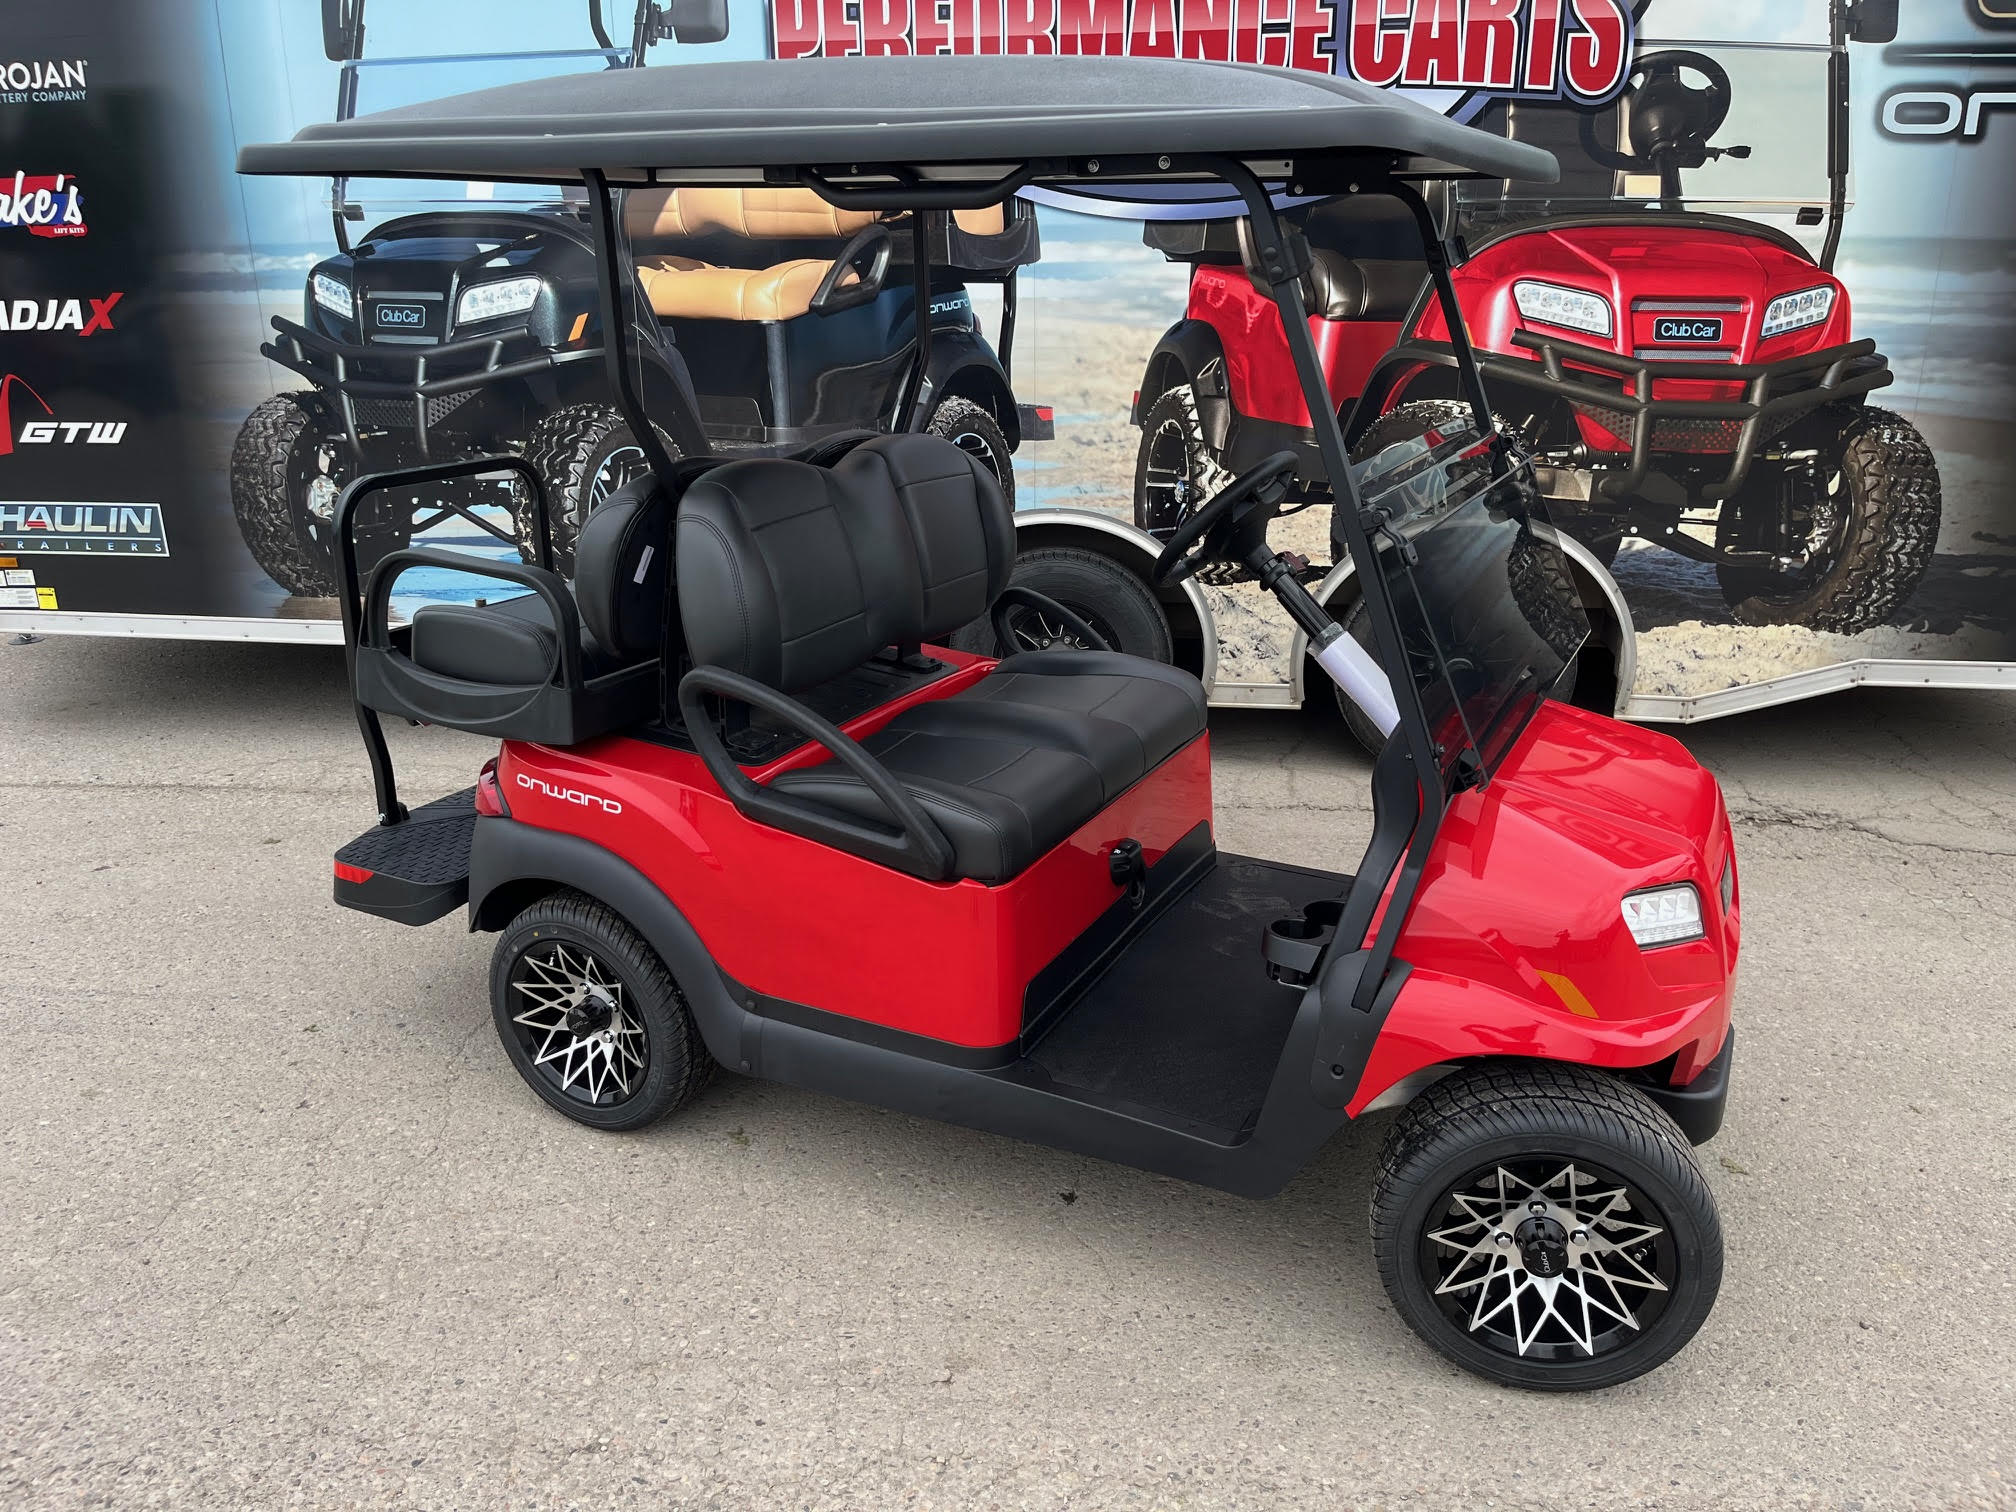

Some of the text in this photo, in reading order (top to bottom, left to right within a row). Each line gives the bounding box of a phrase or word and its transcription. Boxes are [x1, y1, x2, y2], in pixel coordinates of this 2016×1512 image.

[32, 90, 86, 102] COMPANY
[381, 309, 420, 322] Club Car
[1661, 322, 1716, 337] Club Car
[18, 421, 128, 444] GTW
[0, 506, 152, 534] HAULIN
